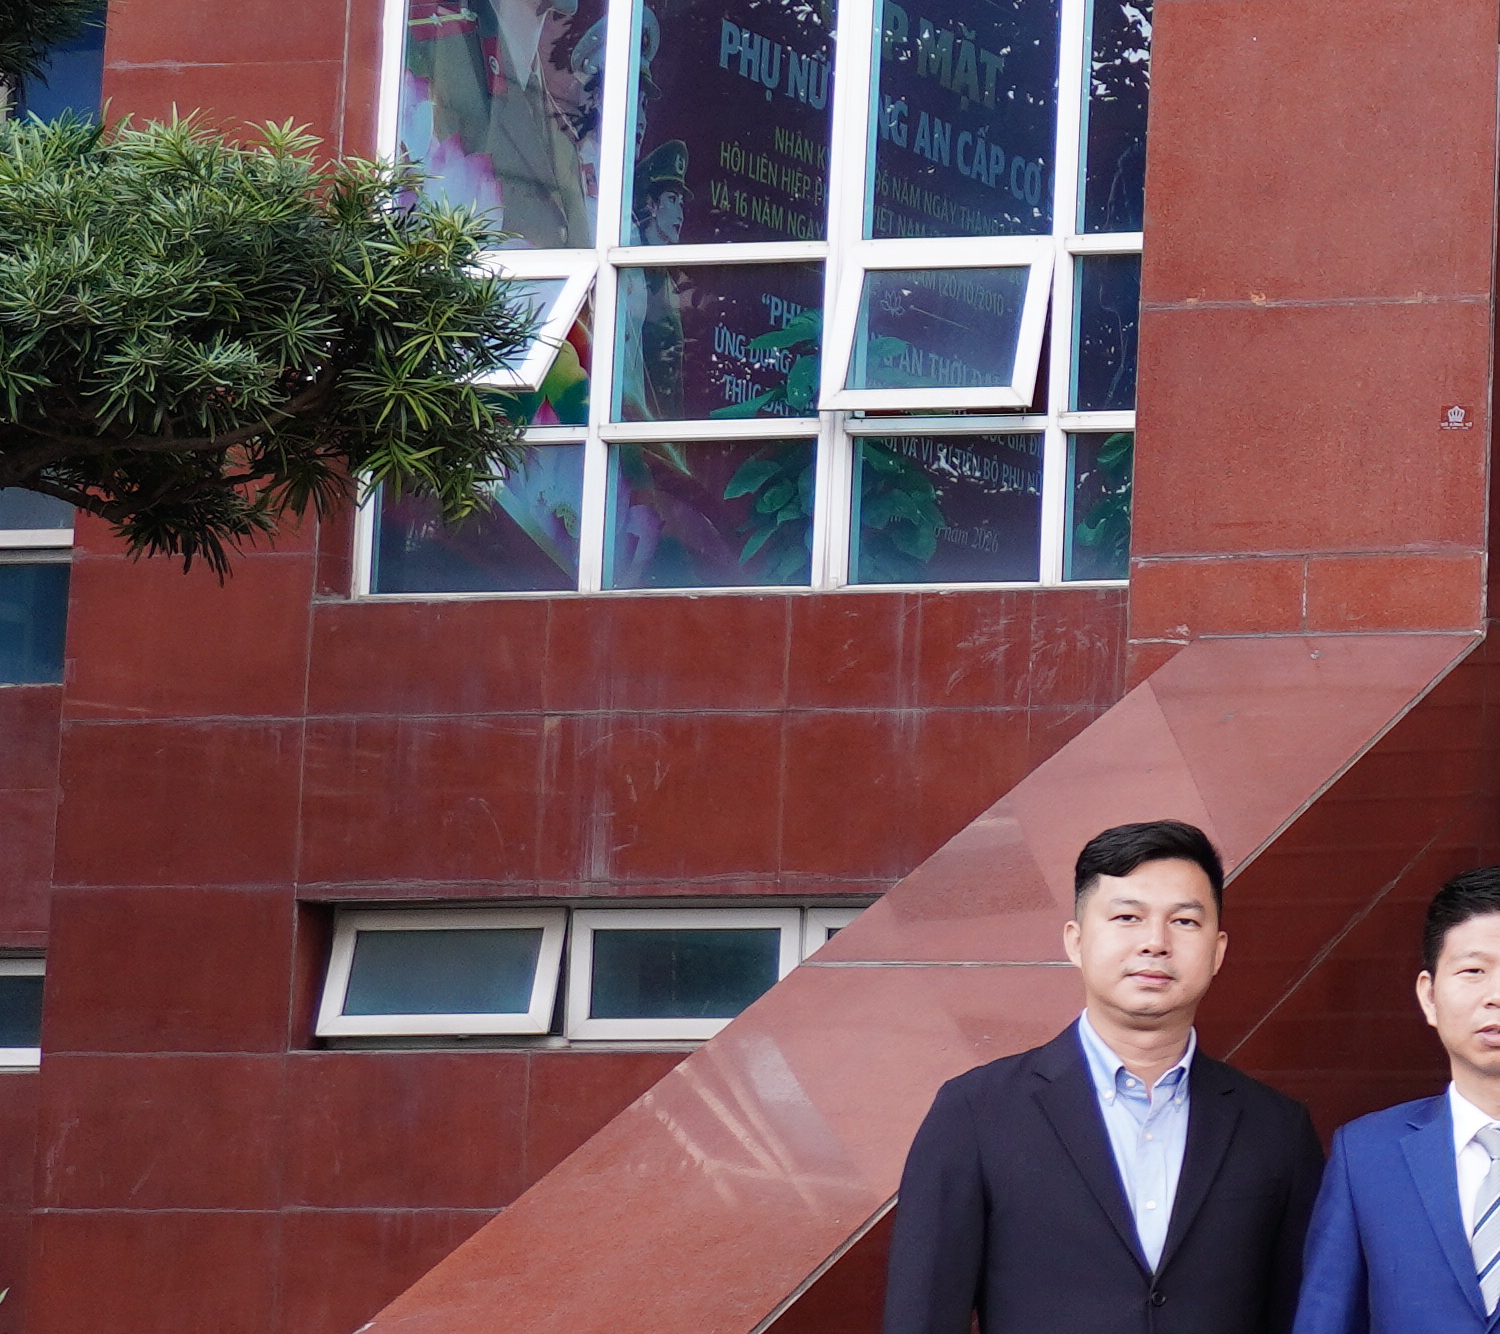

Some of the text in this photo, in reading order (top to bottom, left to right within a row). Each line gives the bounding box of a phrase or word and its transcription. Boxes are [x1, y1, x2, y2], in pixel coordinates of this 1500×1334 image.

[917, 16, 1005, 112] MẶT
[718, 17, 782, 101] PHỤ
[914, 110, 952, 167] AN
[957, 125, 1006, 188] CẤP
[1010, 155, 1043, 207] CƠ
[710, 179, 731, 212] VÀ
[734, 189, 748, 217] 16
[751, 194, 784, 231] NĂM
[720, 140, 746, 177] HỘI
[748, 152, 778, 188] LIÊN
[781, 166, 811, 201] HIỆP
[774, 125, 814, 166] NHÂN
[892, 176, 921, 212] NĂM
[983, 454, 1000, 488] BỘ
